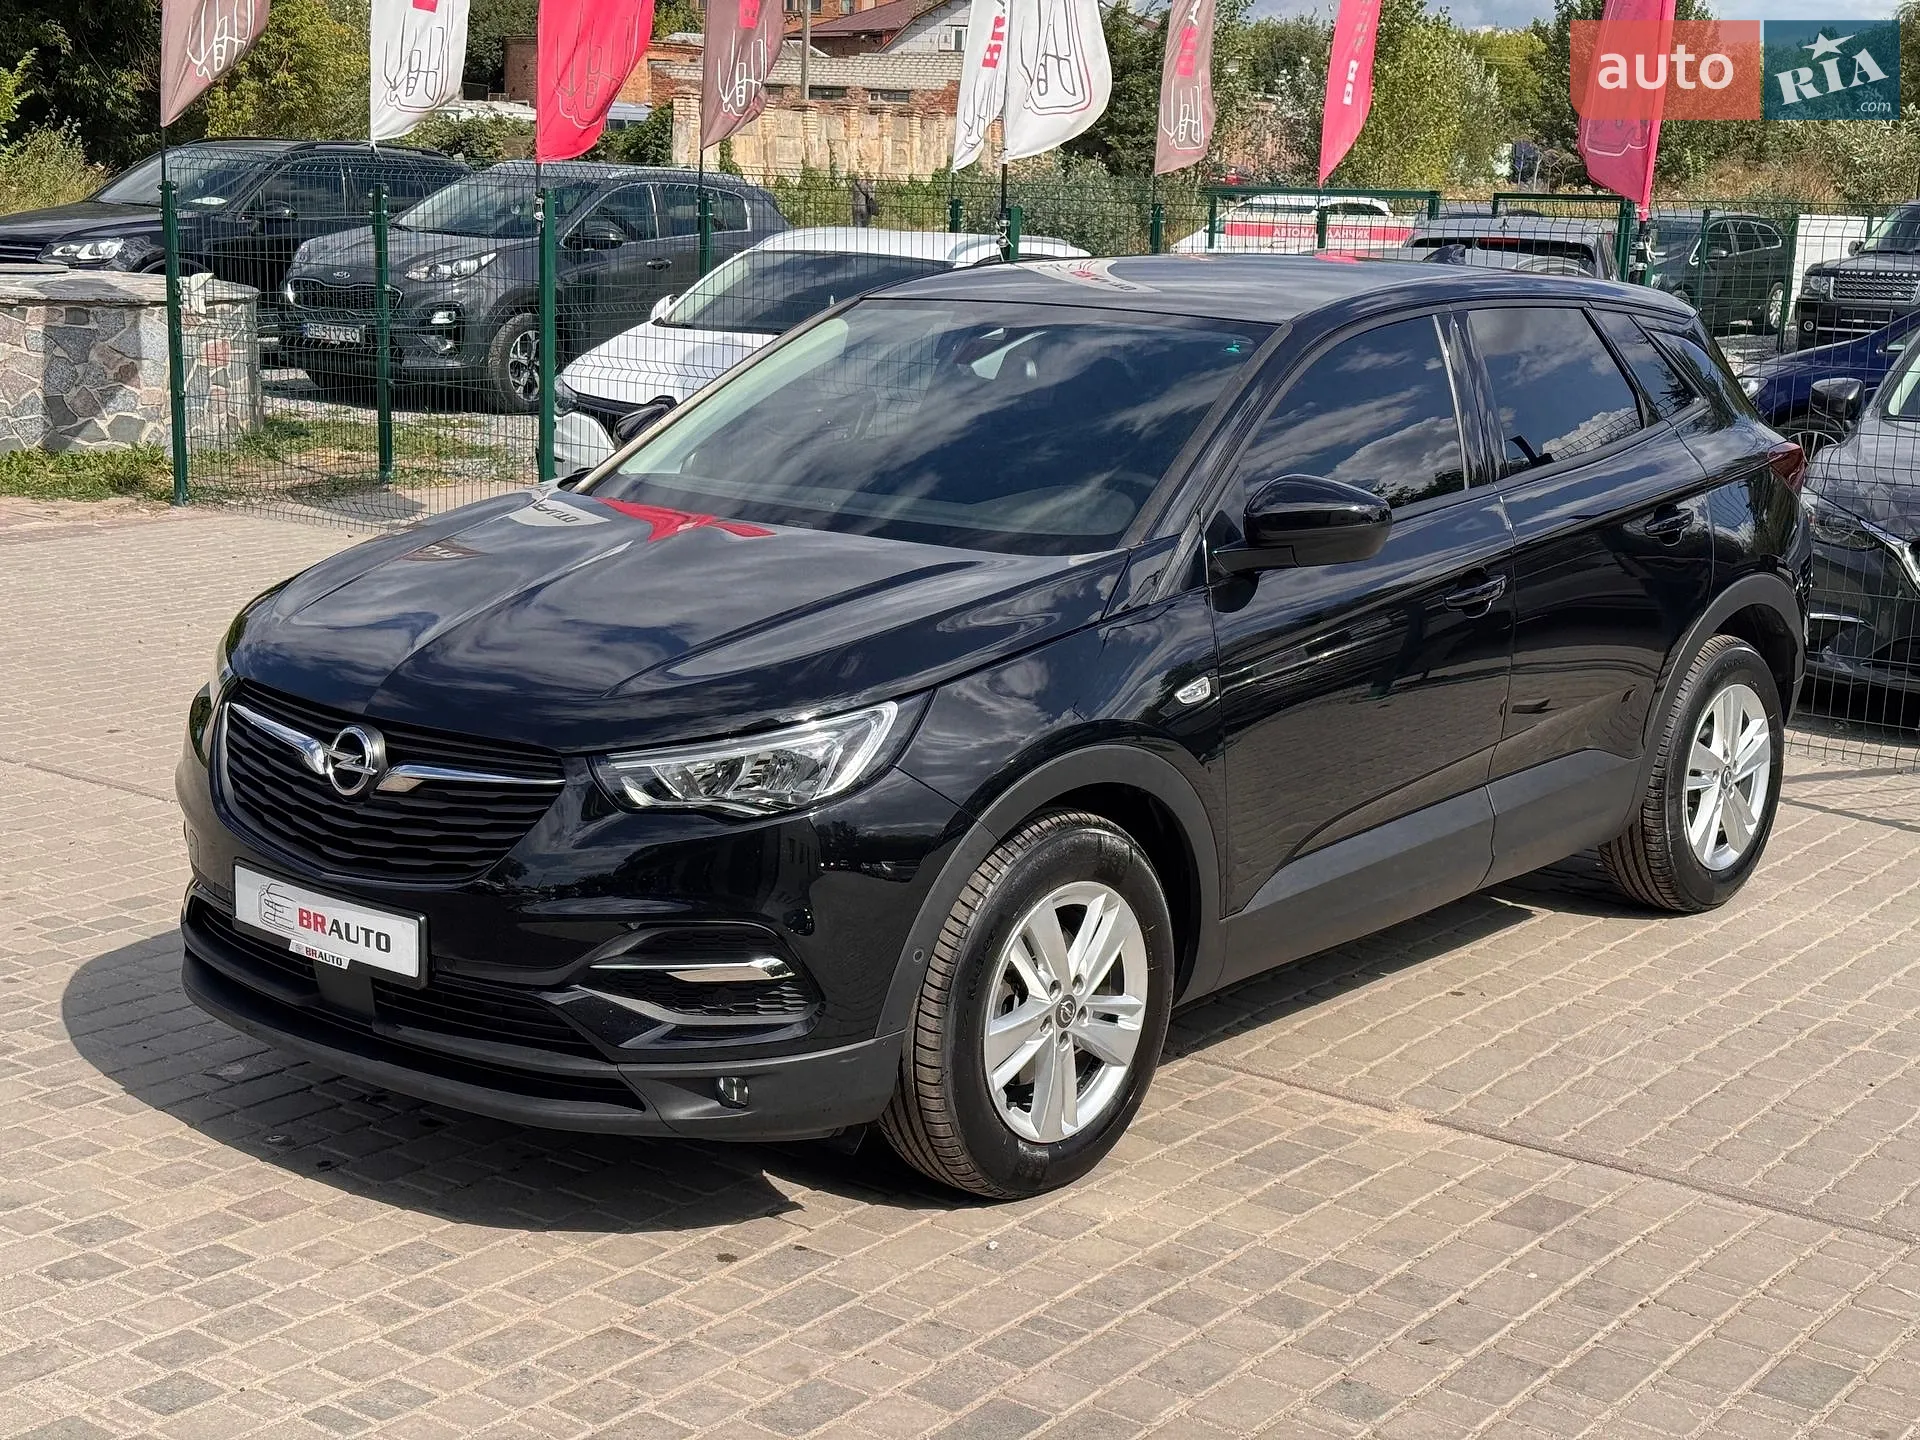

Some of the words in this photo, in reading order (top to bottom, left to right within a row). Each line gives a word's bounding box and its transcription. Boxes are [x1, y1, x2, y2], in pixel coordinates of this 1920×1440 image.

[1273, 226, 1370, 239] АВТОМАДАНЧИК
[298, 907, 391, 954] BRAUTO
[305, 946, 343, 967] BRAUTO
